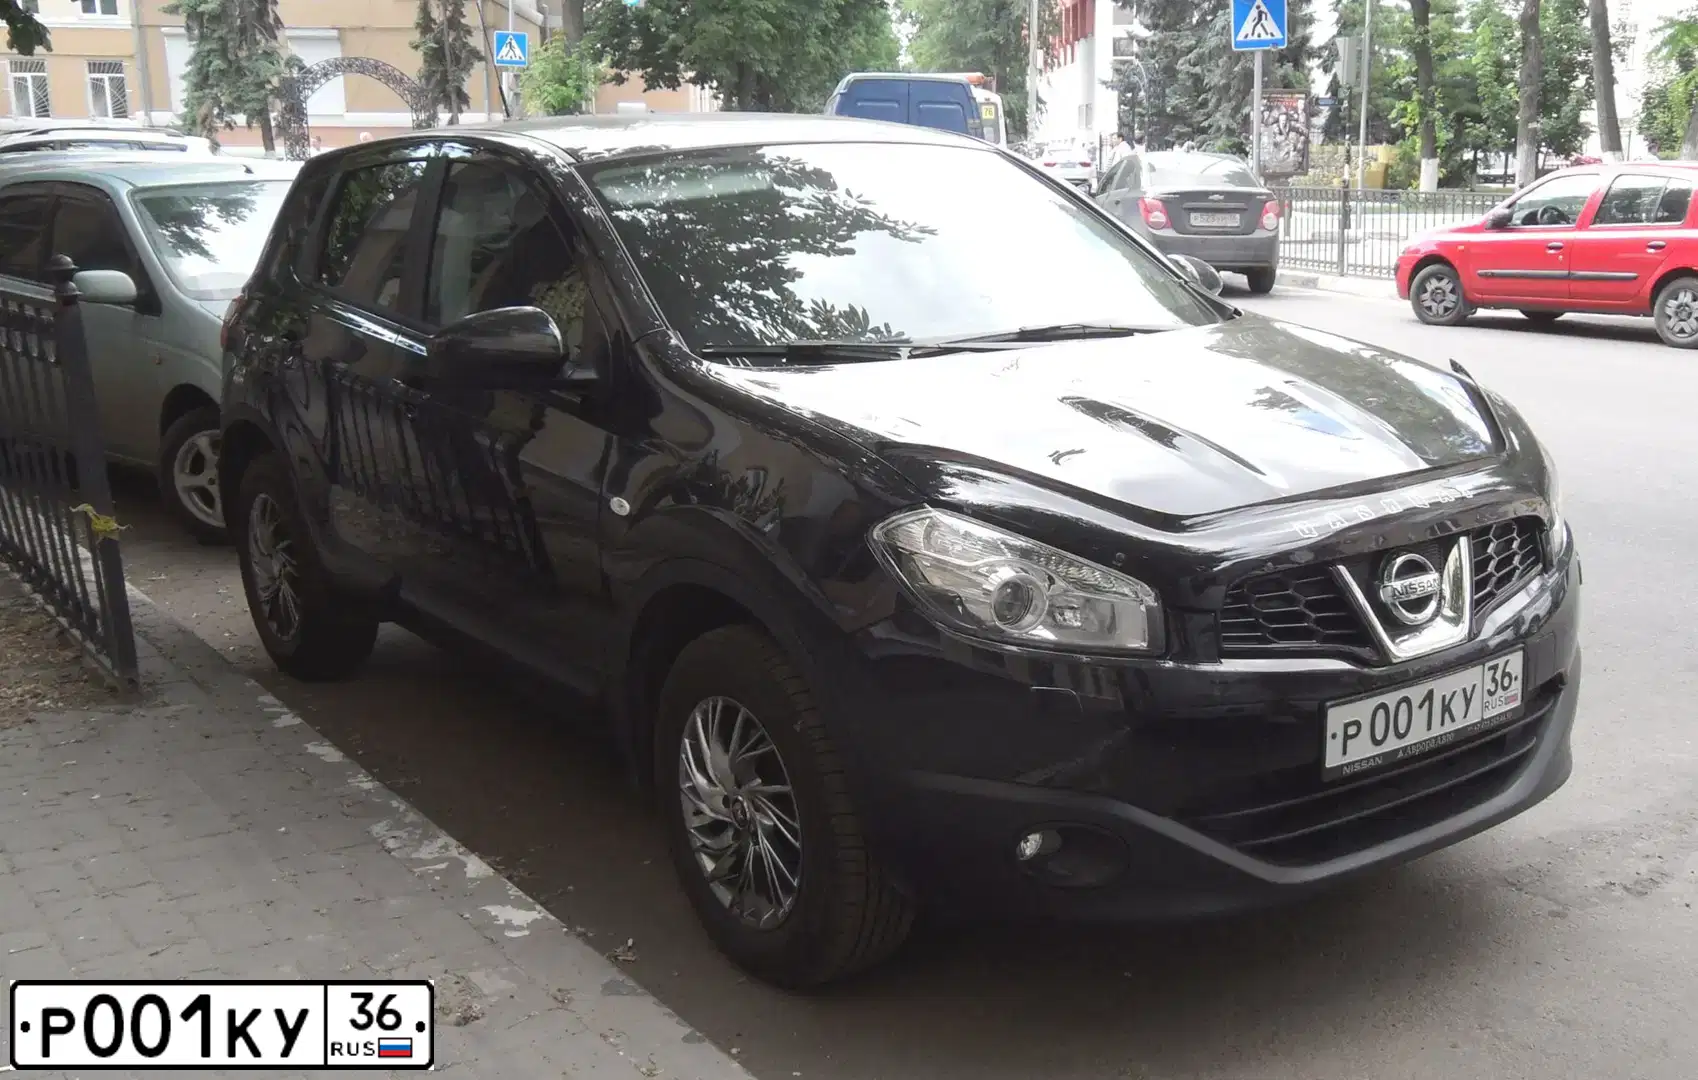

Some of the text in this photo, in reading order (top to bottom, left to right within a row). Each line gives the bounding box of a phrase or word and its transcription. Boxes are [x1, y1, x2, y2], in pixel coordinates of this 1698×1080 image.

[1392, 577, 1440, 599] NISSAN
[1341, 659, 1513, 756] Р001КУ 36
[1484, 698, 1504, 712] RUS
[1342, 755, 1383, 776] NISSAN
